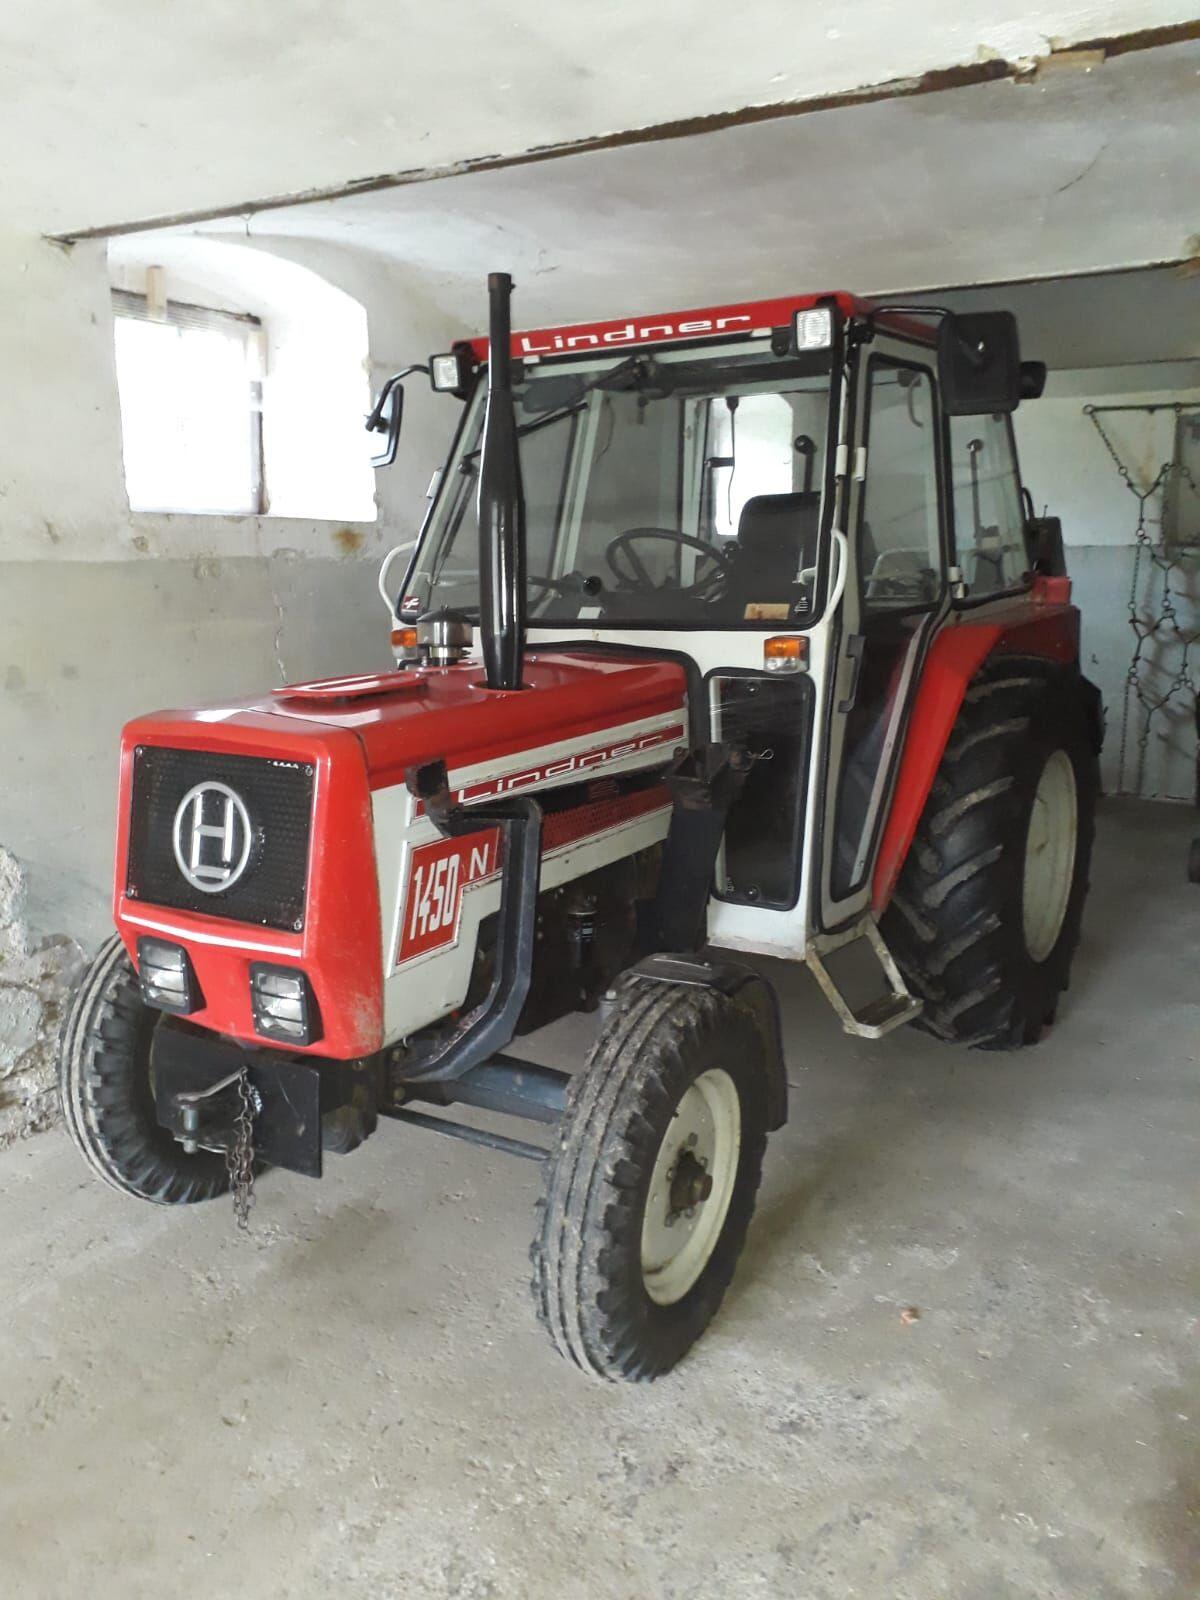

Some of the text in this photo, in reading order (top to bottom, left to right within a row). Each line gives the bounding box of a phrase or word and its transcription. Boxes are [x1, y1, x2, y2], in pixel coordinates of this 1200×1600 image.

[521, 315, 751, 353] Lindner
[457, 735, 663, 803] Lindner
[409, 843, 489, 941] 1450 N
